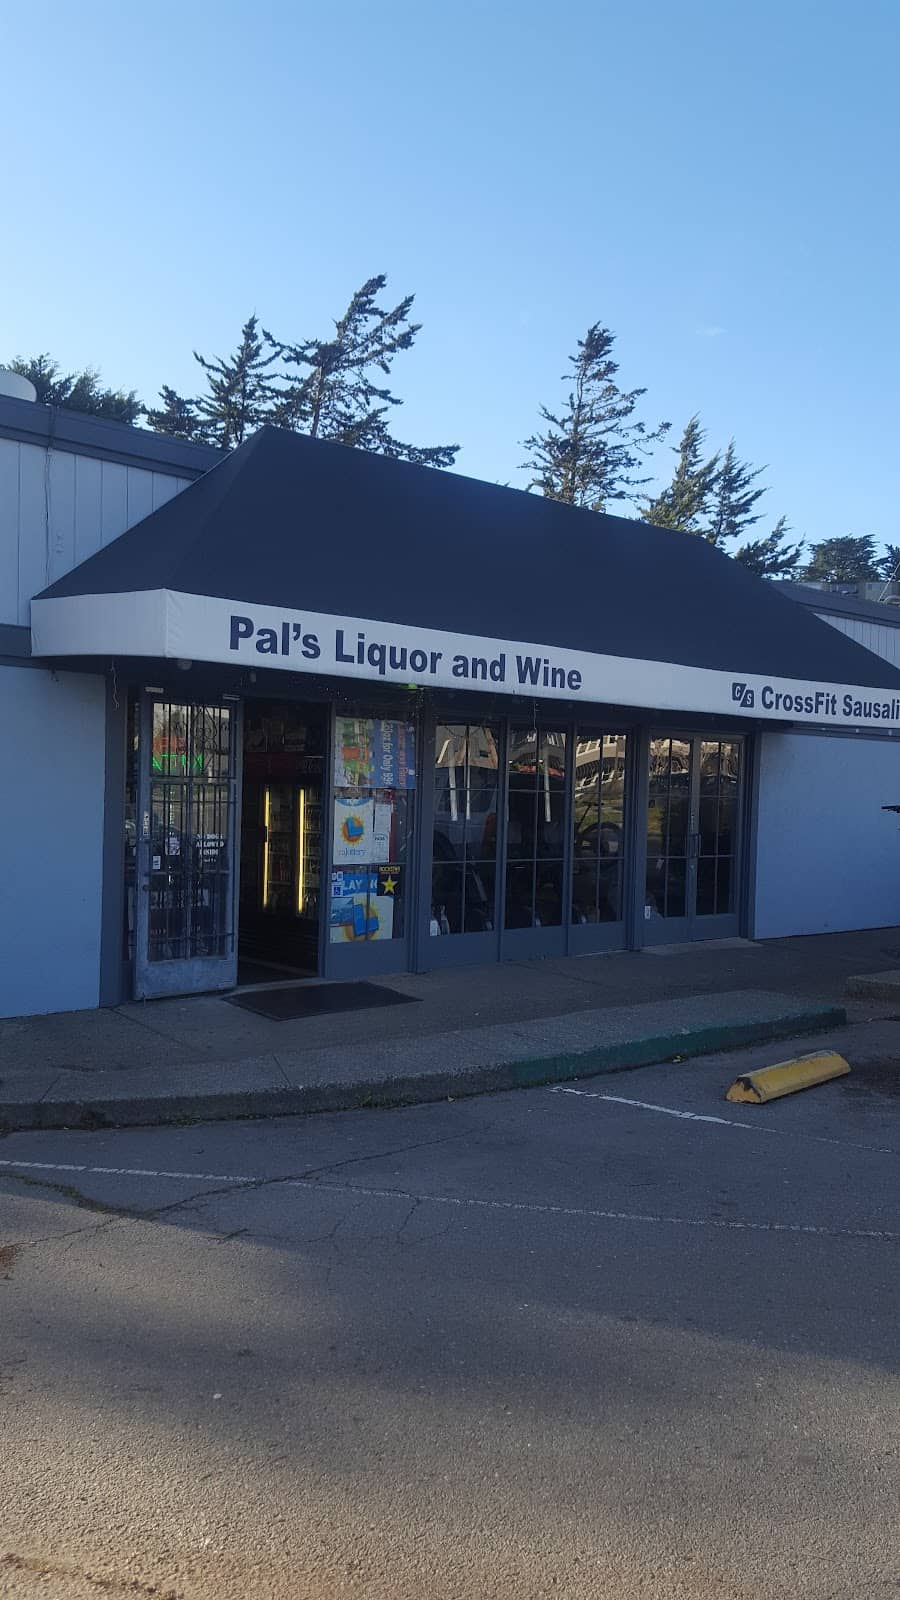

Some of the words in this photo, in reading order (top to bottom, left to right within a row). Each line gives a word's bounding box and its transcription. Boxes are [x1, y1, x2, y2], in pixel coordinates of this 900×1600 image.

[230, 615, 321, 660] Pal's
[335, 629, 443, 676] Liquor
[451, 653, 506, 683] and
[515, 655, 582, 691] Wine
[761, 685, 838, 717] CrossFit
[842, 694, 900, 720] Sausali
